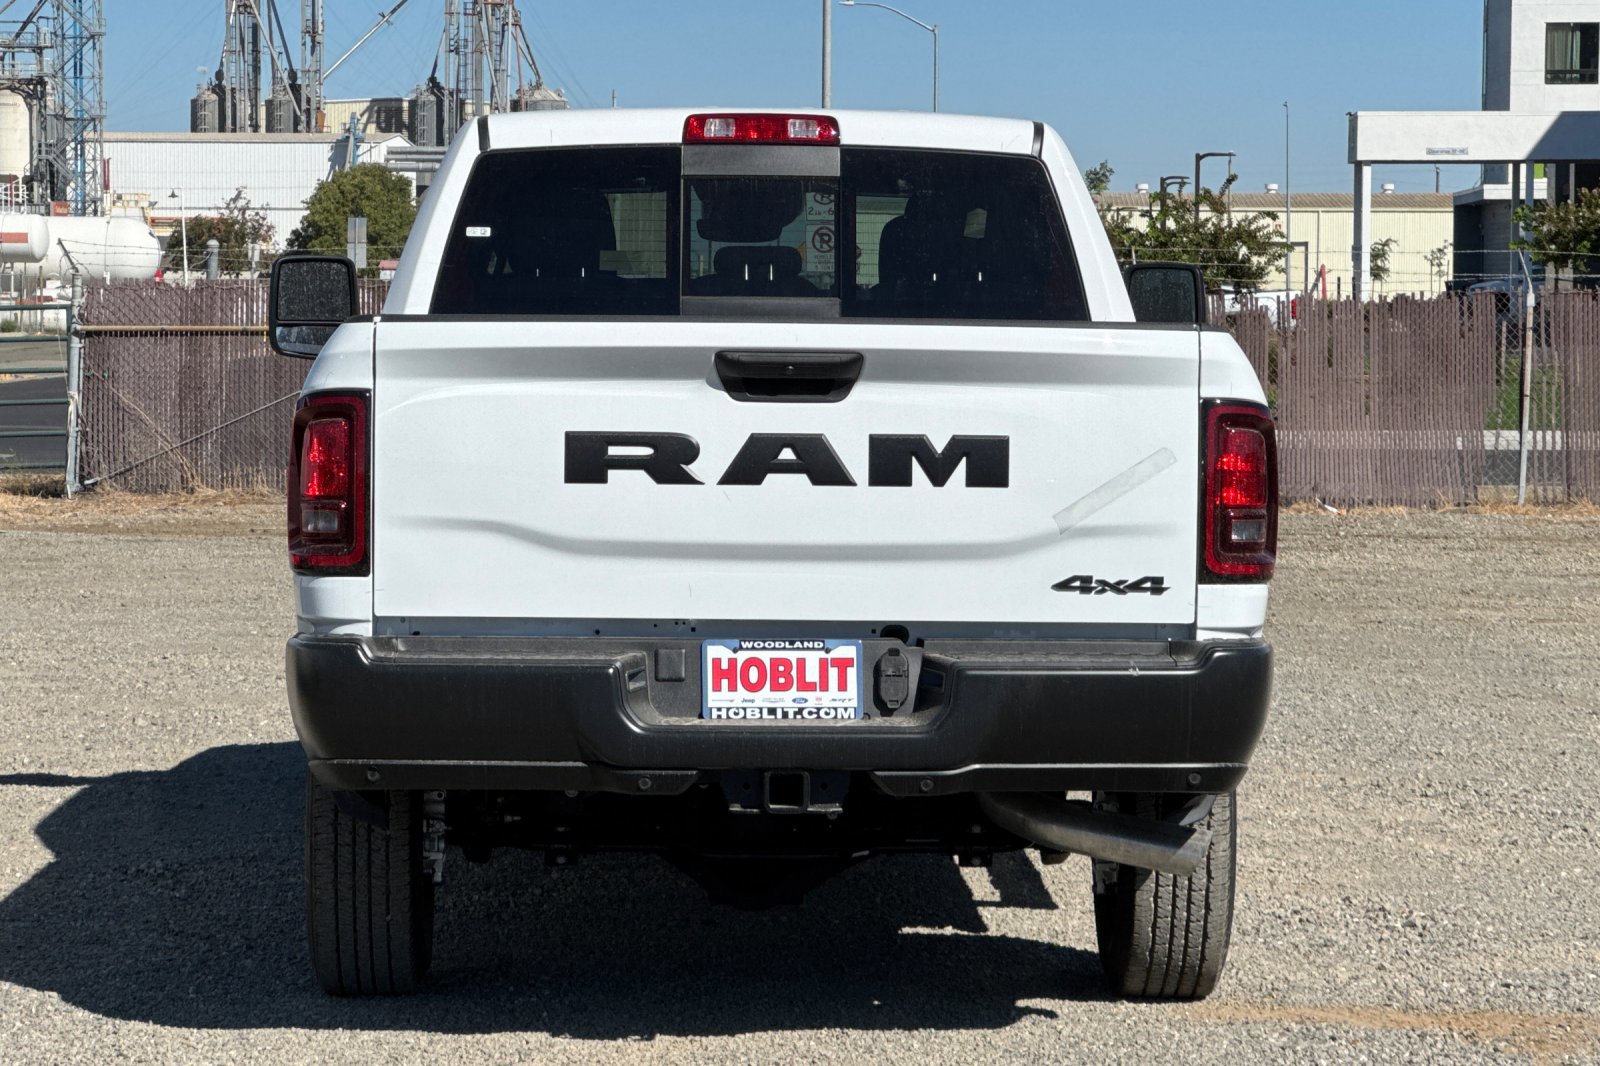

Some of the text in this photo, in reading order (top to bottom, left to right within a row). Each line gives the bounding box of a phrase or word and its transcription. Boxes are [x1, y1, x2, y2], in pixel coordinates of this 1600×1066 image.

[564, 430, 1010, 488] RAM
[1050, 574, 1171, 596] 4x4
[740, 640, 824, 649] WOODLAND
[711, 656, 855, 693] HOBLIT
[711, 707, 856, 719] HOBLIT.COM
